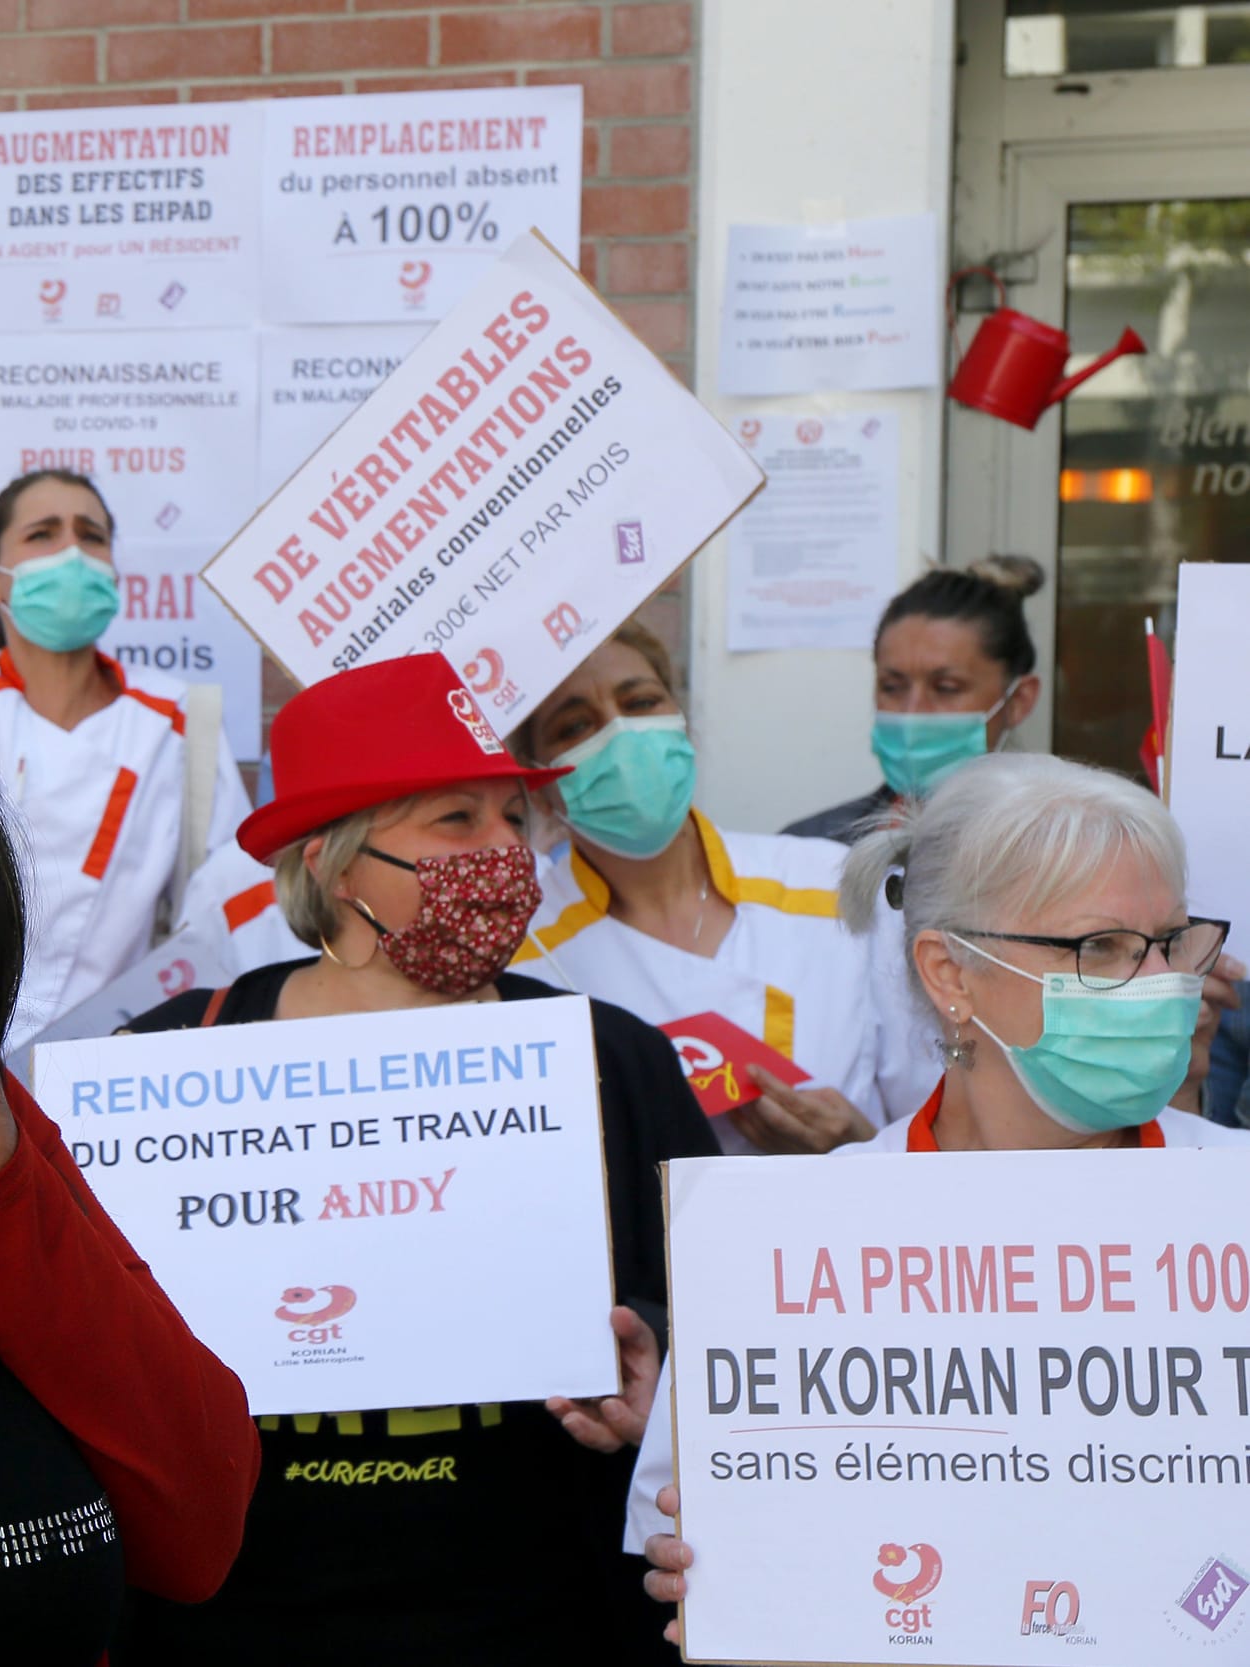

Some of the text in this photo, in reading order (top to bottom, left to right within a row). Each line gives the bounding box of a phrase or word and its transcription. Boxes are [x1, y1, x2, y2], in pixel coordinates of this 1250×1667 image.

[293, 116, 547, 158] REMPLACEMENT
[16, 166, 206, 195] DES EFFECTIFS
[280, 163, 559, 198] du personnel absent
[8, 199, 213, 228] DANS LES EHPAD
[371, 200, 500, 245] 100%
[106, 446, 187, 474] TOUS
[252, 289, 551, 606] DE VÉRITABLES
[296, 334, 593, 649] AUGMENTATIONS
[331, 373, 624, 675] salariales conventionnelles
[473, 547, 522, 602] NET
[519, 501, 573, 555] PAR
[566, 440, 631, 508] MOIS
[118, 574, 196, 621] RAI
[115, 636, 214, 672] mois
[1216, 725, 1250, 760] L
[70, 1041, 557, 1118] RENOUVELLEMENT
[73, 1104, 562, 1169] DU CONTRAT DE TRAVAIL
[176, 1167, 458, 1231] POUR ANDY
[774, 1246, 846, 1315] LA
[860, 1244, 1039, 1315] PRIME
[1057, 1243, 1137, 1314] DE
[287, 1323, 343, 1345] cgt
[291, 1346, 347, 1358] KORIAN
[706, 1346, 780, 1416] DE
[799, 1345, 1019, 1418] KORIAN
[1038, 1345, 1208, 1418] POUR
[284, 1456, 458, 1486] #CURVEPOWER
[709, 1448, 818, 1482] sans
[834, 1442, 1050, 1483] éléments
[885, 1603, 933, 1634] cgt
[1020, 1580, 1081, 1636] FO
[888, 1634, 934, 1646] KORIAN
